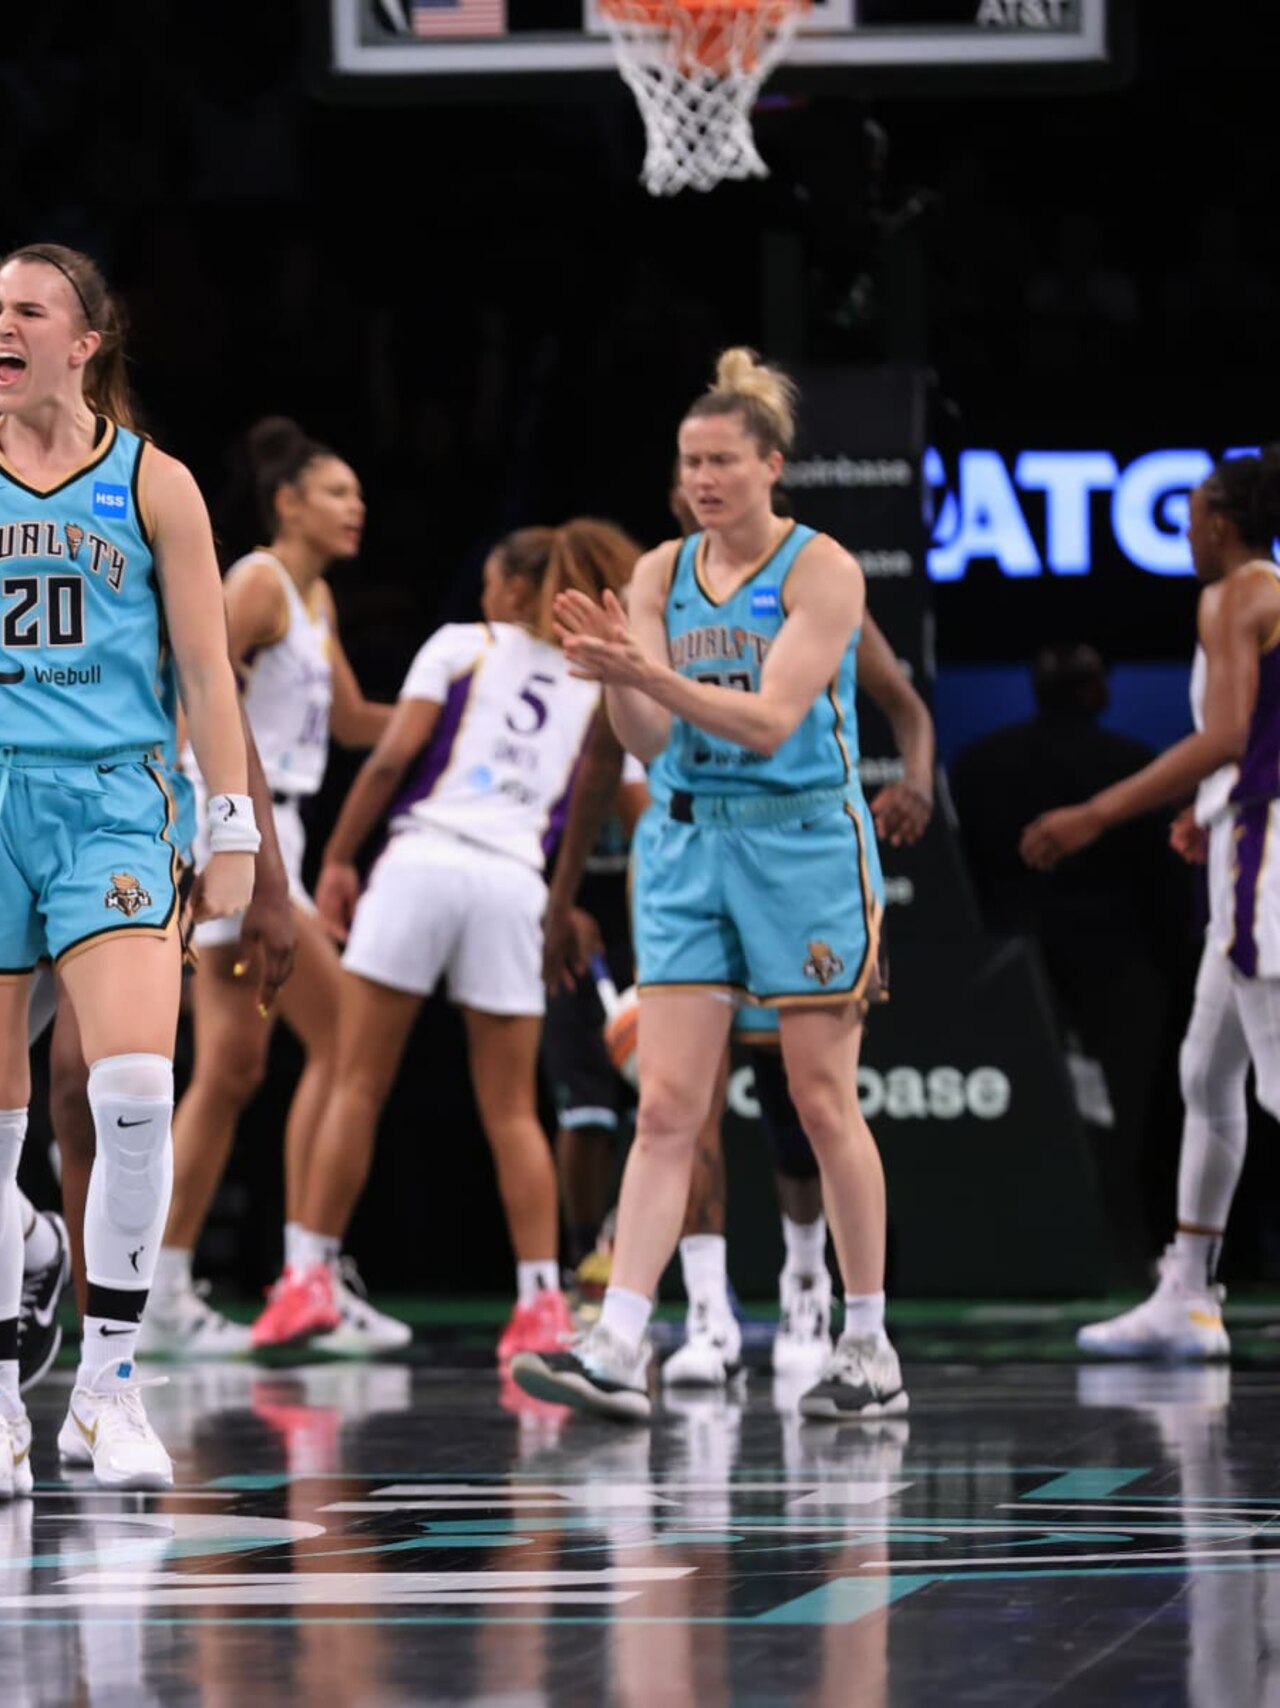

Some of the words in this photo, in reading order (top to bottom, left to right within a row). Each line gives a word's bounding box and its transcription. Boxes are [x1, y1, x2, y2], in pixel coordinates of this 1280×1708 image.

[95, 492, 125, 508] HSS
[0, 574, 86, 649] 20
[33, 665, 102, 685] Webull
[504, 671, 556, 737] 5
